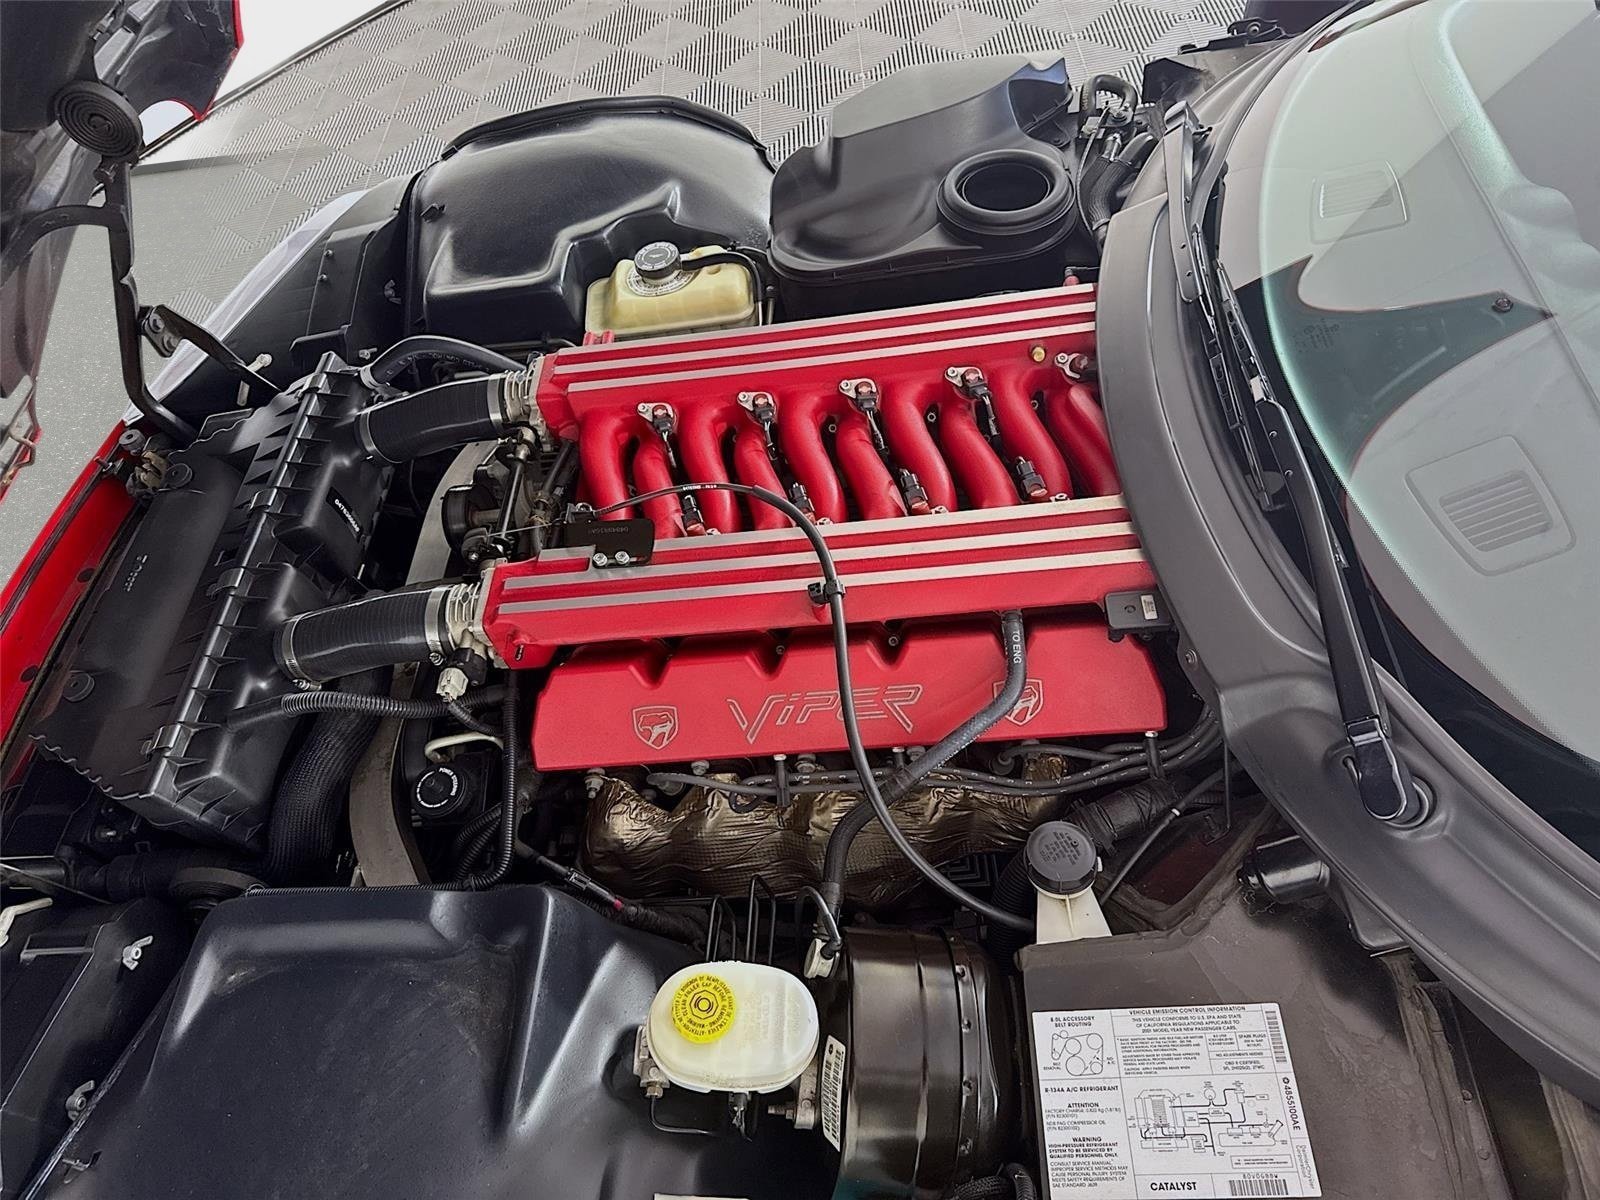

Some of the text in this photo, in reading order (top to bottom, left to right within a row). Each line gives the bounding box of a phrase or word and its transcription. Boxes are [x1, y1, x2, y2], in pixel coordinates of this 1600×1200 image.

[1012, 630, 1022, 664] TO ENG
[726, 684, 924, 745] VIPER
[1284, 1085, 1301, 1131] 4855100AE
[1150, 1182, 1197, 1191] CATALYST
